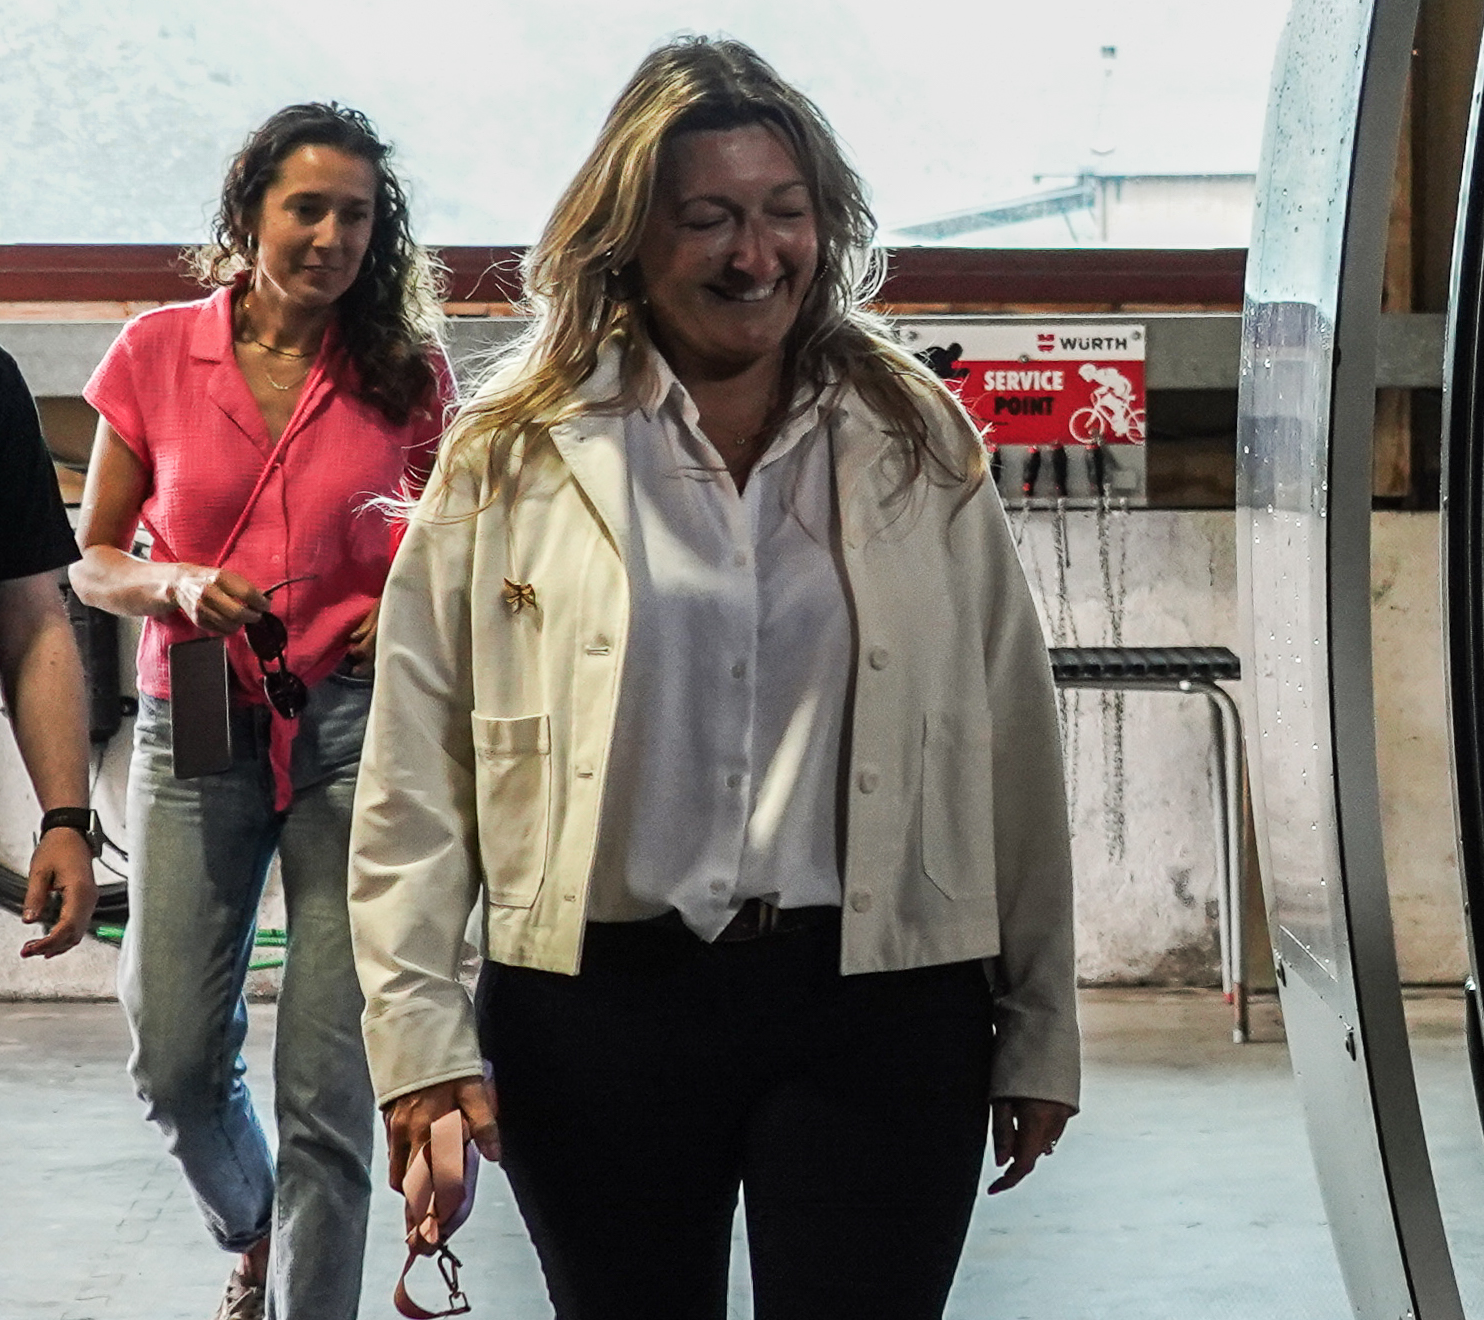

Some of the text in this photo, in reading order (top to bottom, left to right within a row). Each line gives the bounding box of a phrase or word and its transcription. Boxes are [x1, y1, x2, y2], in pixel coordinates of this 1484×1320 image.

[1059, 337, 1128, 351] WÜRTH
[984, 370, 1065, 392] SERVICE
[994, 396, 1055, 416] POINT
